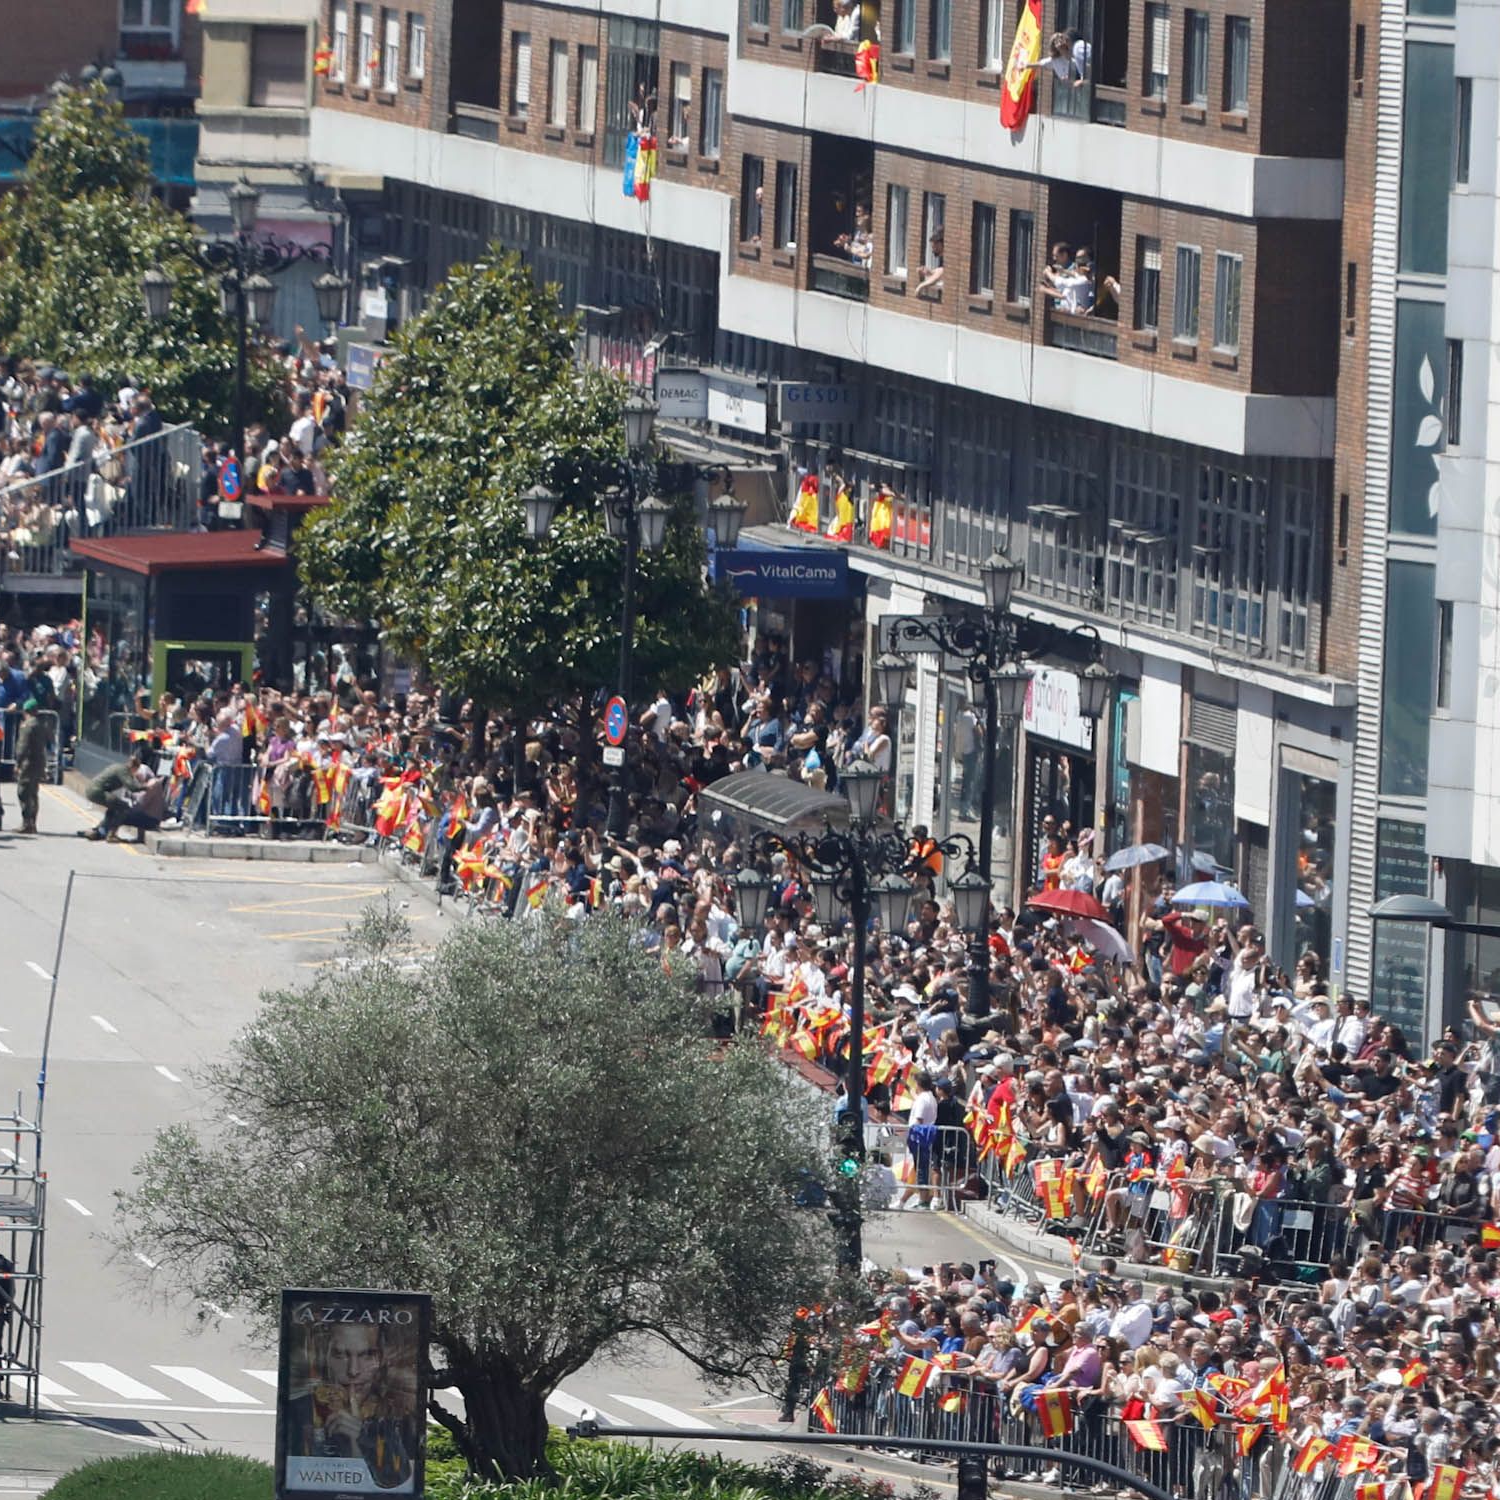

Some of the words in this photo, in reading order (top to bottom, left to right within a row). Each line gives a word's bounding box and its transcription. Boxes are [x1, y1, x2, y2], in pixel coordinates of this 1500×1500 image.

[659, 388, 700, 400] DEMAG
[760, 564, 837, 579] VitalCama
[299, 1307, 413, 1325] AZZARO
[299, 1470, 363, 1485] WANTED
